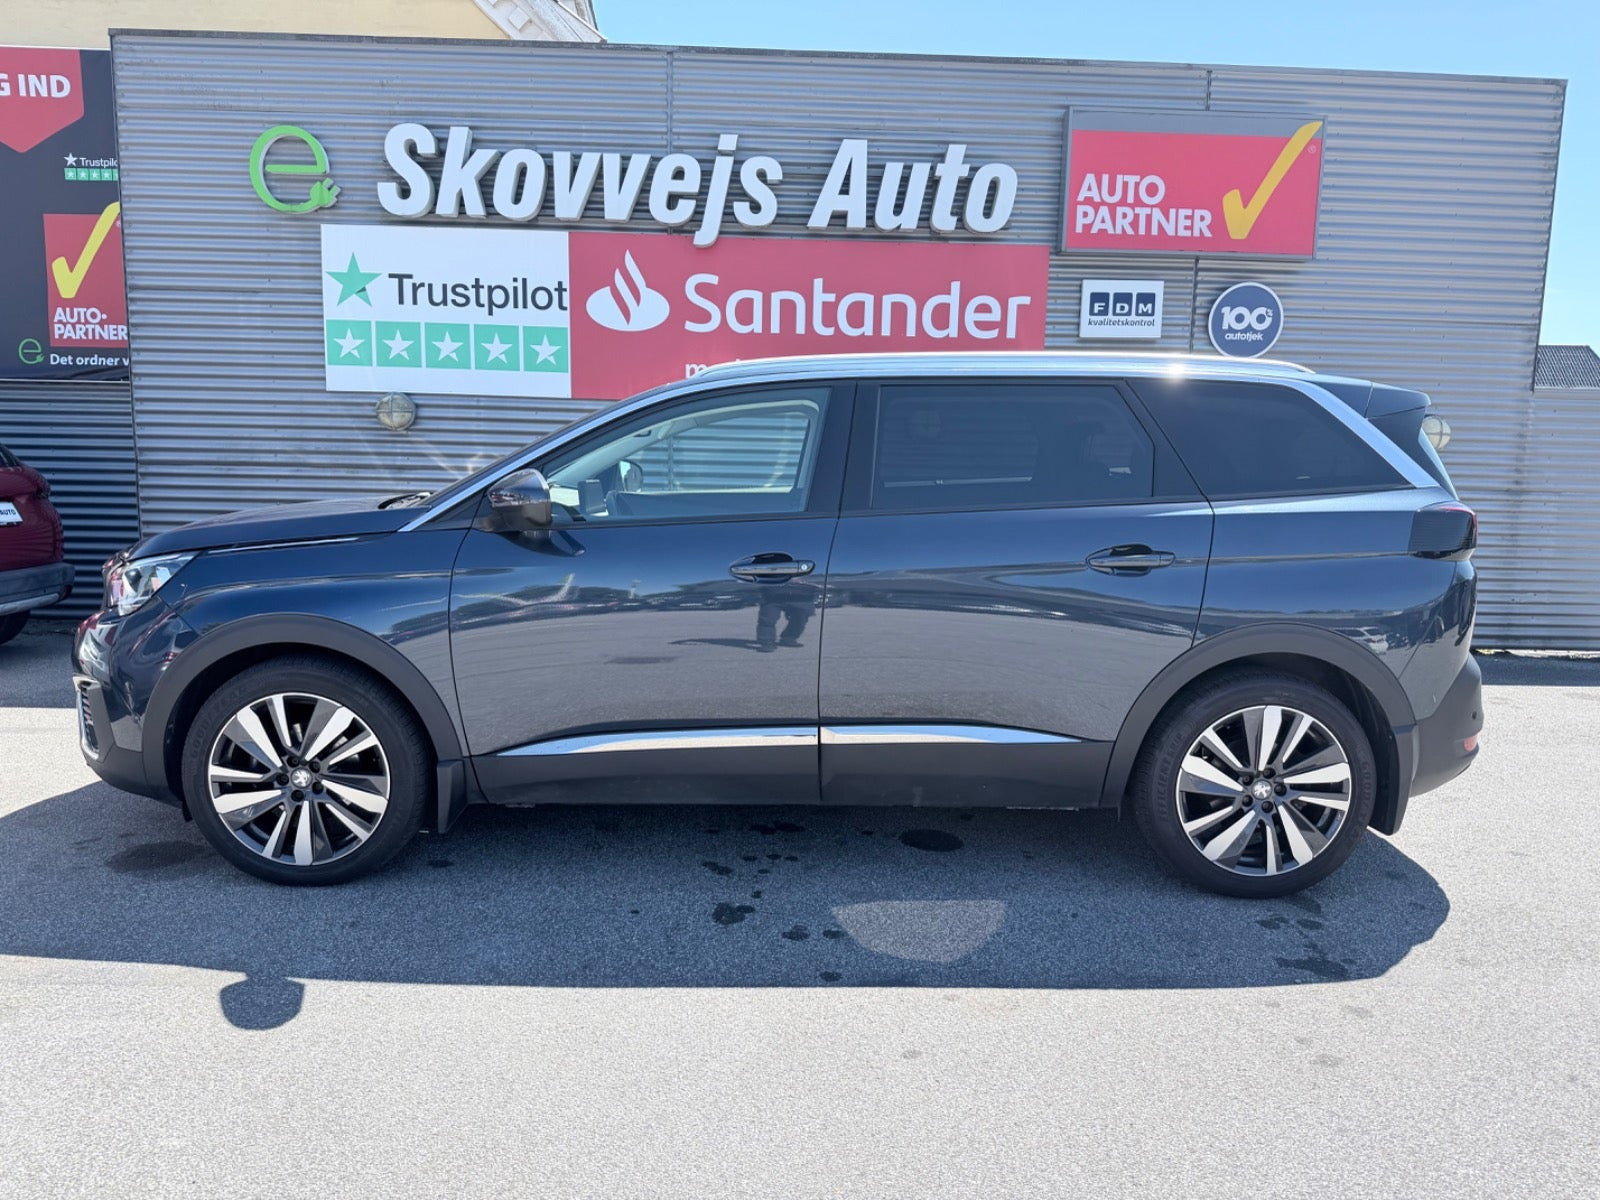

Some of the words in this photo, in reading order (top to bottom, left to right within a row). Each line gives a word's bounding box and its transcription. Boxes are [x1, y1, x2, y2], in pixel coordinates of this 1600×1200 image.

[18, 74, 71, 98] IND
[376, 122, 783, 248] Skovvejs
[806, 138, 1018, 233] Auto
[1076, 173, 1166, 205] AUTO
[1075, 204, 1212, 237] PARTNER
[388, 272, 568, 316] Trustpilot
[684, 272, 1031, 339] Santander
[54, 323, 128, 340] PARTNER
[1088, 318, 1155, 327] kvalitetskontrol
[1225, 331, 1264, 342] autotjek
[50, 353, 73, 365] Det
[76, 354, 119, 366] ordner
